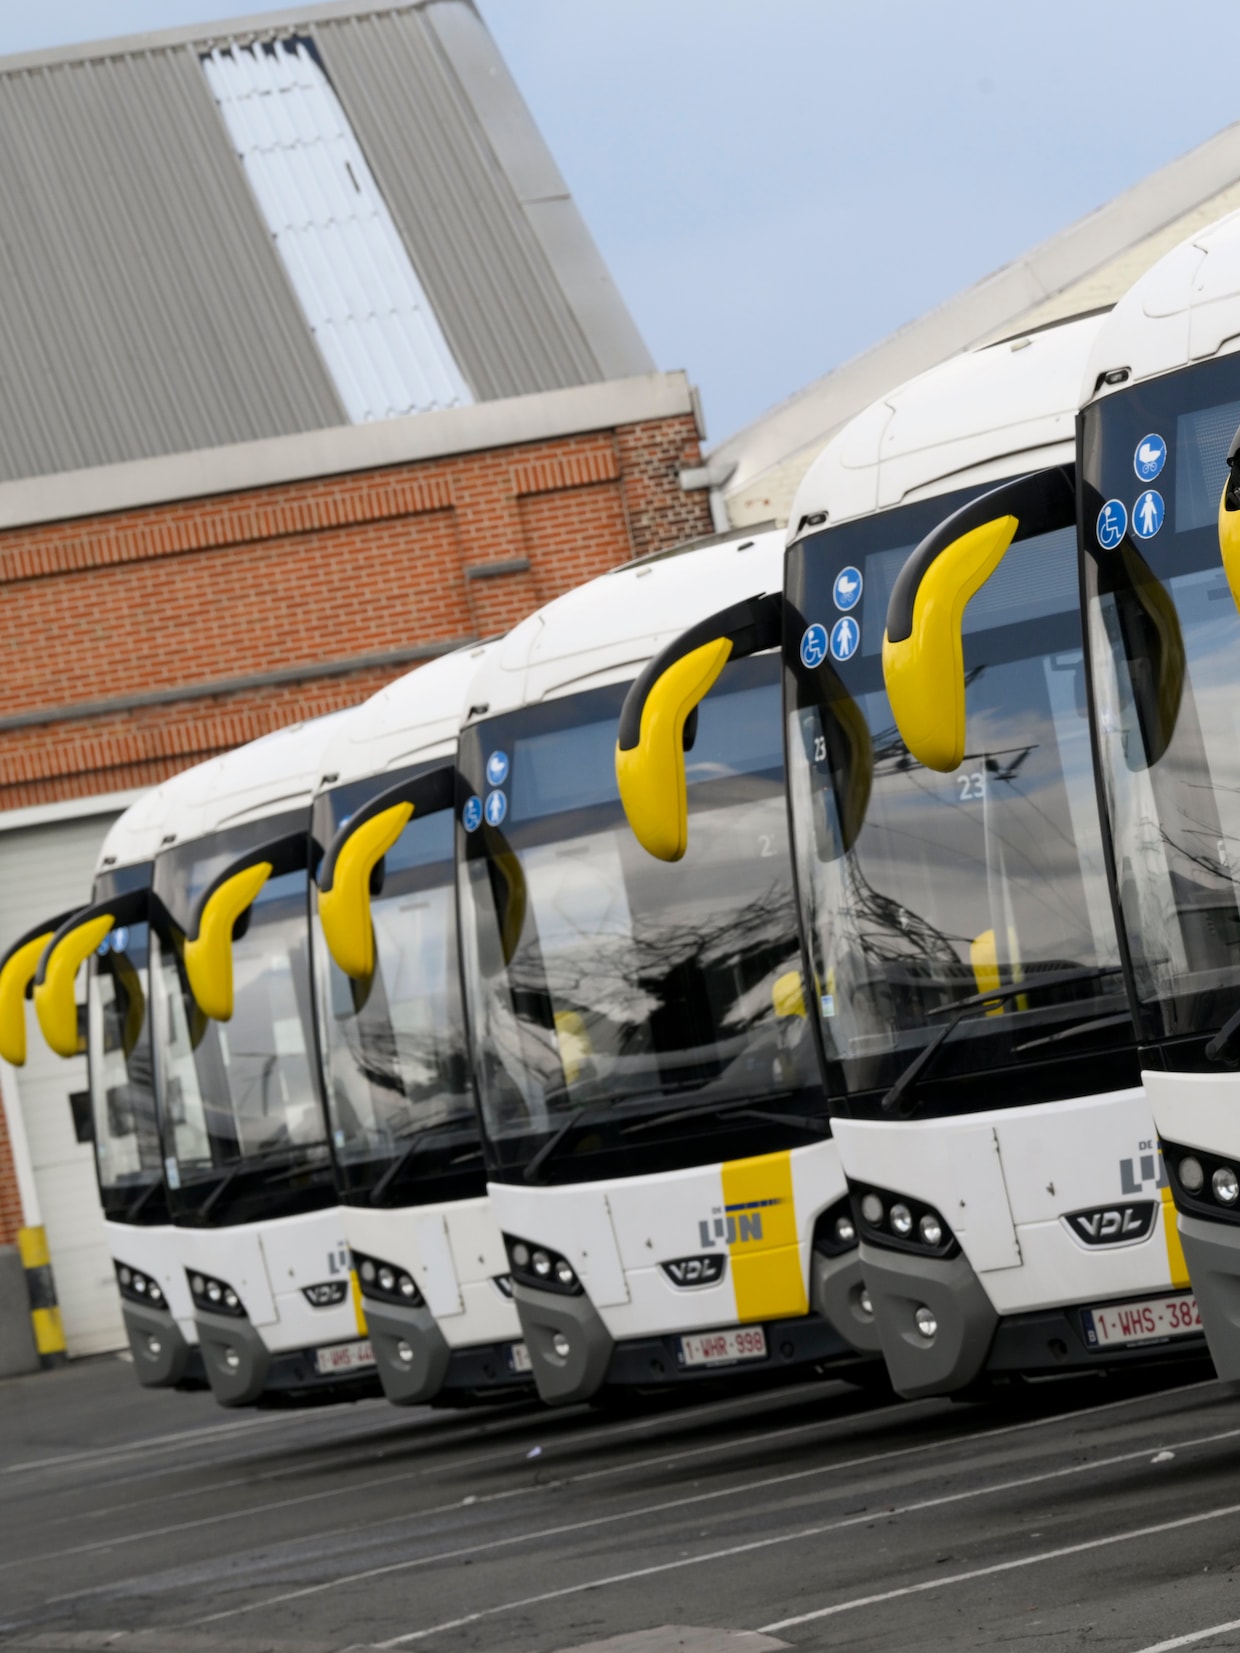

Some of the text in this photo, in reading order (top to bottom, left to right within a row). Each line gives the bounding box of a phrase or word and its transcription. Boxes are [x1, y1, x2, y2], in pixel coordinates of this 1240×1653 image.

[1138, 1140, 1153, 1151] DE
[1119, 1153, 1170, 1195] LIJ
[699, 1212, 763, 1249] LIJN
[1077, 1208, 1143, 1236] VDL
[669, 1258, 717, 1281] VDL
